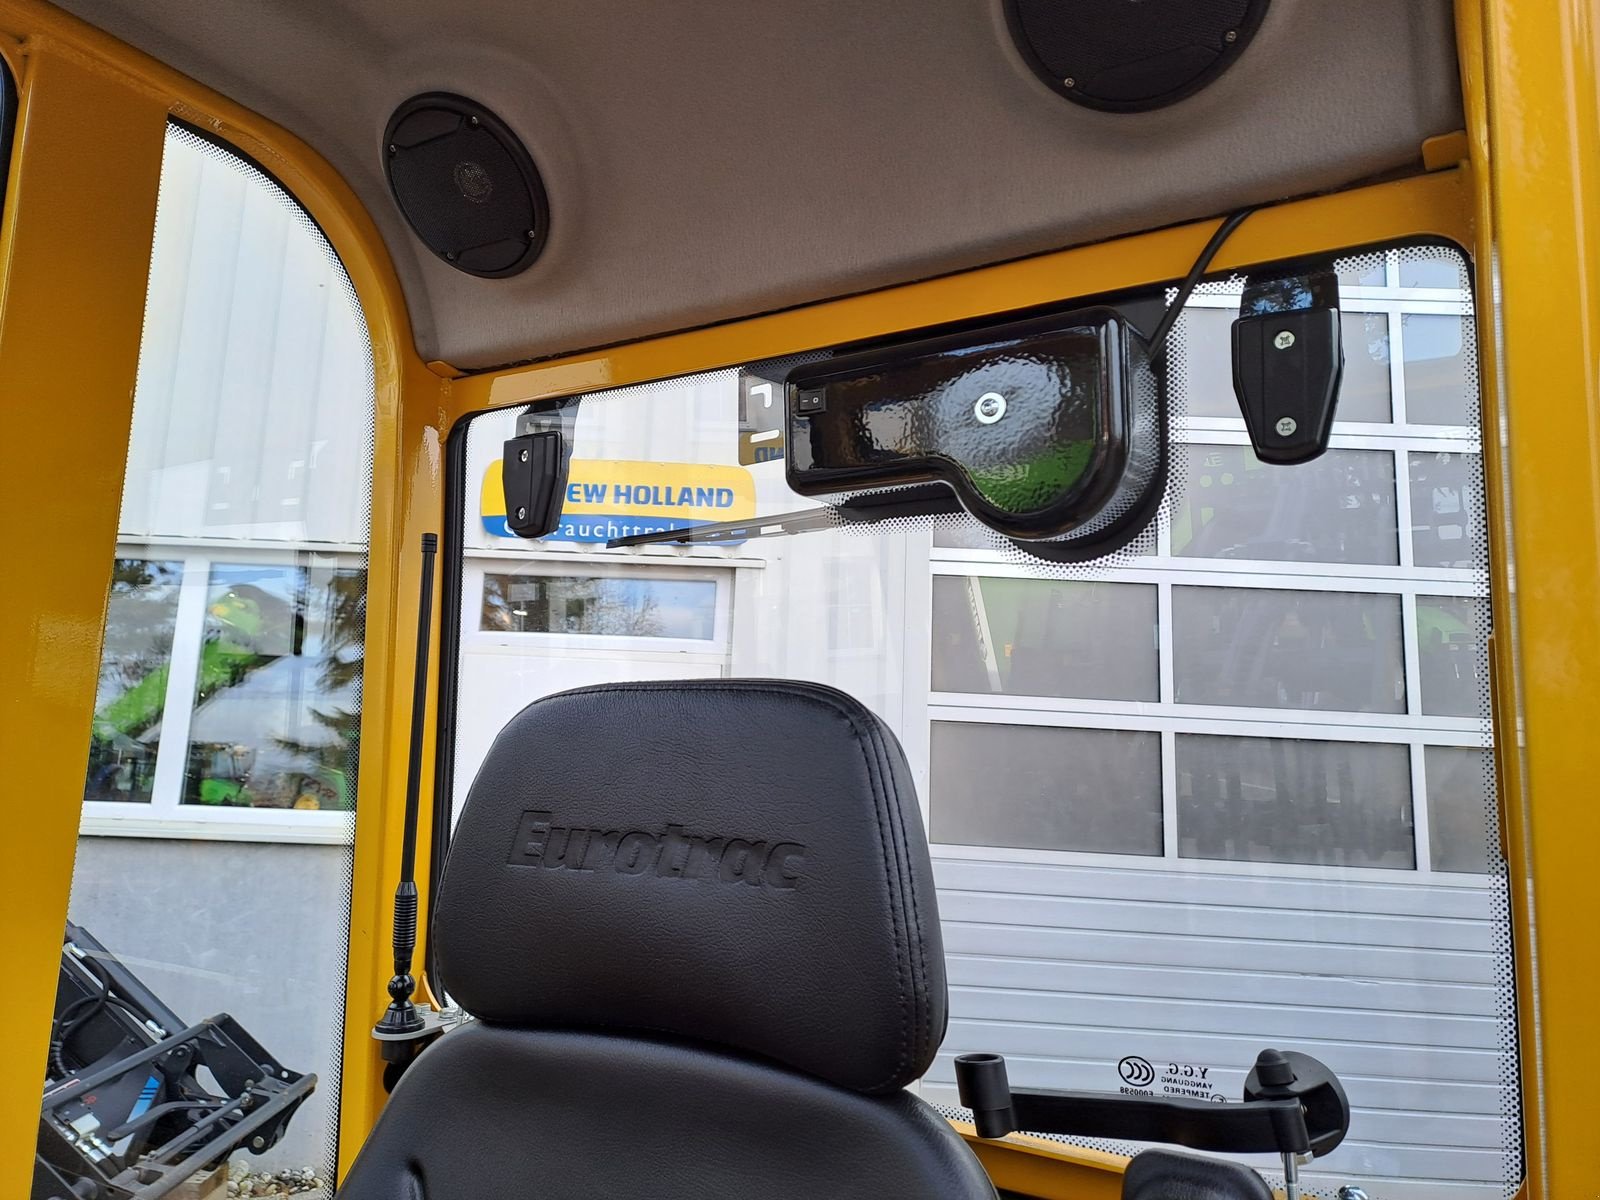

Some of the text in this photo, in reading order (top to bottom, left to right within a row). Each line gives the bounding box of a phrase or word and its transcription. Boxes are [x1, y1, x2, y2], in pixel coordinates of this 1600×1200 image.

[566, 482, 735, 508] EW HOLLAND
[505, 809, 807, 893] Eurotrac
